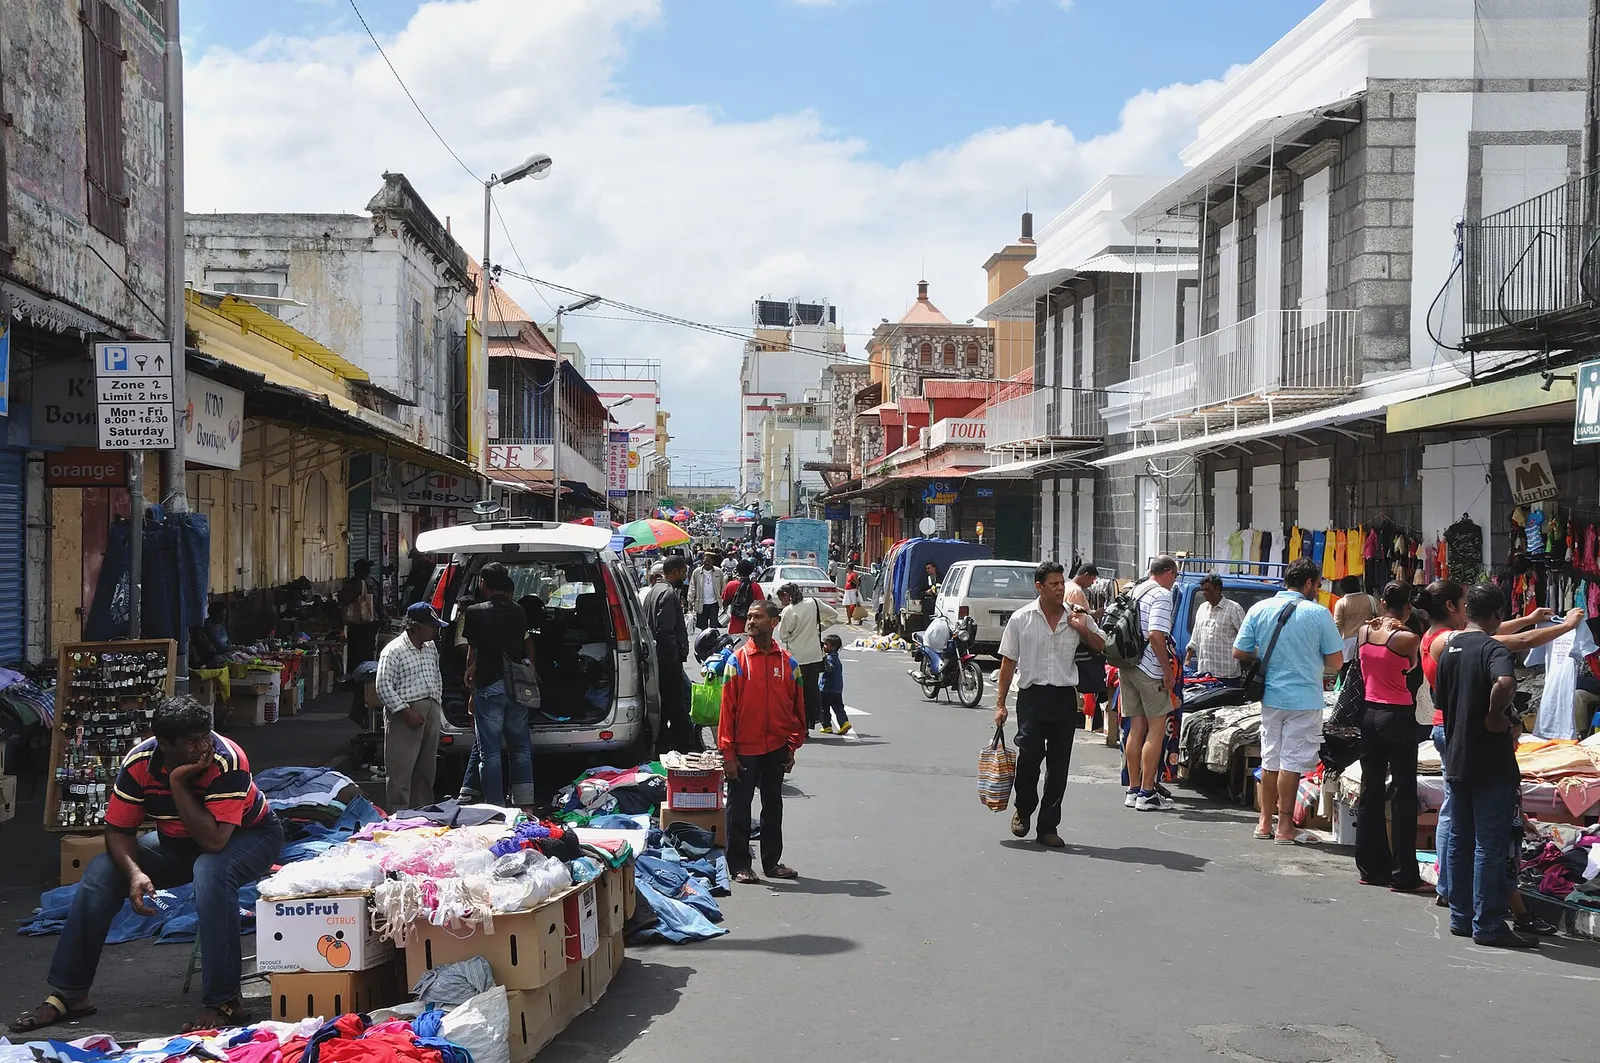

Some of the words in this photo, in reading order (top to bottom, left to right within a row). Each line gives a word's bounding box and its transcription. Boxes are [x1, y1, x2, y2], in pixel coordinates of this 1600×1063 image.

[111, 381, 145, 390] Zone
[152, 380, 161, 389] 2
[103, 392, 132, 401] Limit
[138, 392, 146, 401] 2
[150, 392, 168, 400] hrs
[110, 407, 136, 417] Mon
[147, 406, 163, 416] Fri
[109, 426, 164, 437] Saturday
[105, 439, 129, 447] 8.00
[139, 438, 169, 446] 12.30
[196, 422, 227, 454] Boutique
[50, 464, 116, 480] orange
[1513, 486, 1558, 504] Marlon
[275, 902, 340, 916] SnoFrut
[326, 917, 357, 926] CITRUS
